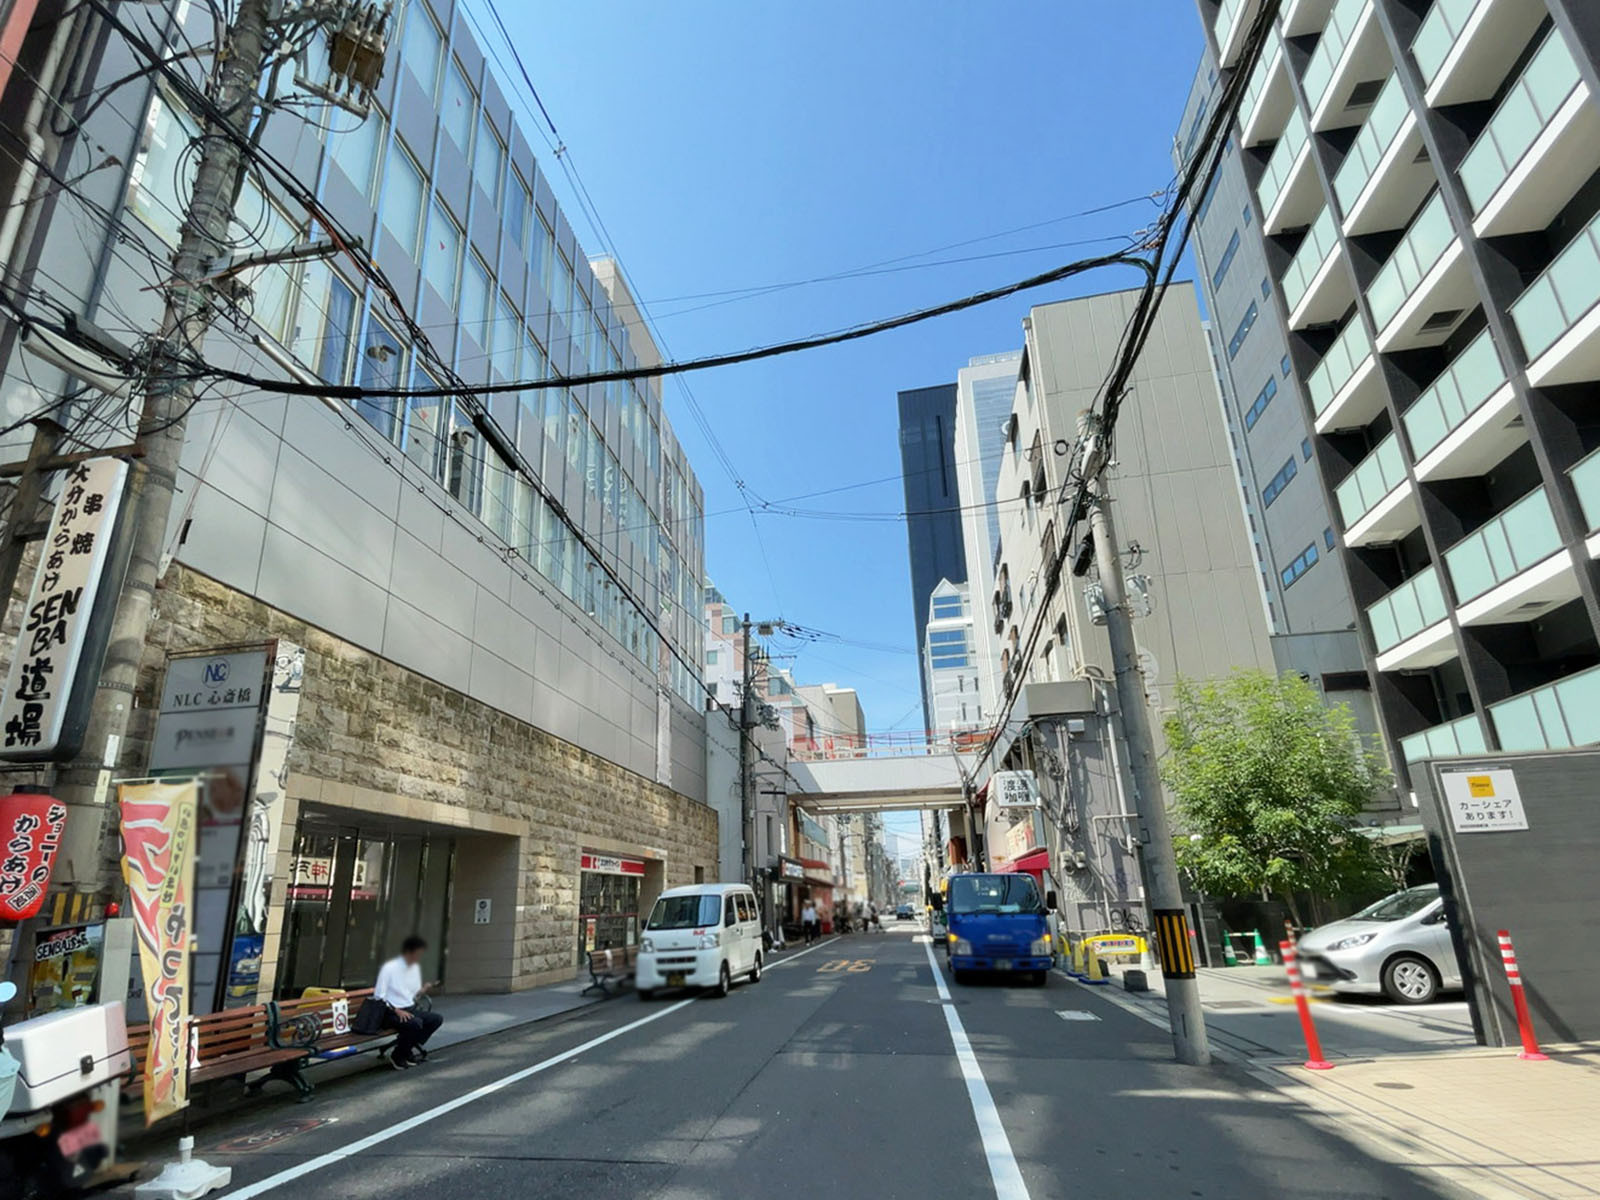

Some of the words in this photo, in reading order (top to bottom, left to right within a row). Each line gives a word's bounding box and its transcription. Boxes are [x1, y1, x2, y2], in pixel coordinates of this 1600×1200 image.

[70, 494, 103, 555] 串焼
[26, 587, 83, 632] SEN
[30, 620, 67, 657] BA
[5, 658, 53, 747] 道場
[173, 692, 203, 707] NLC
[207, 687, 252, 705] 心斎橋
[1459, 799, 1512, 810] カーシェア
[32, 804, 66, 883] ジョニーの
